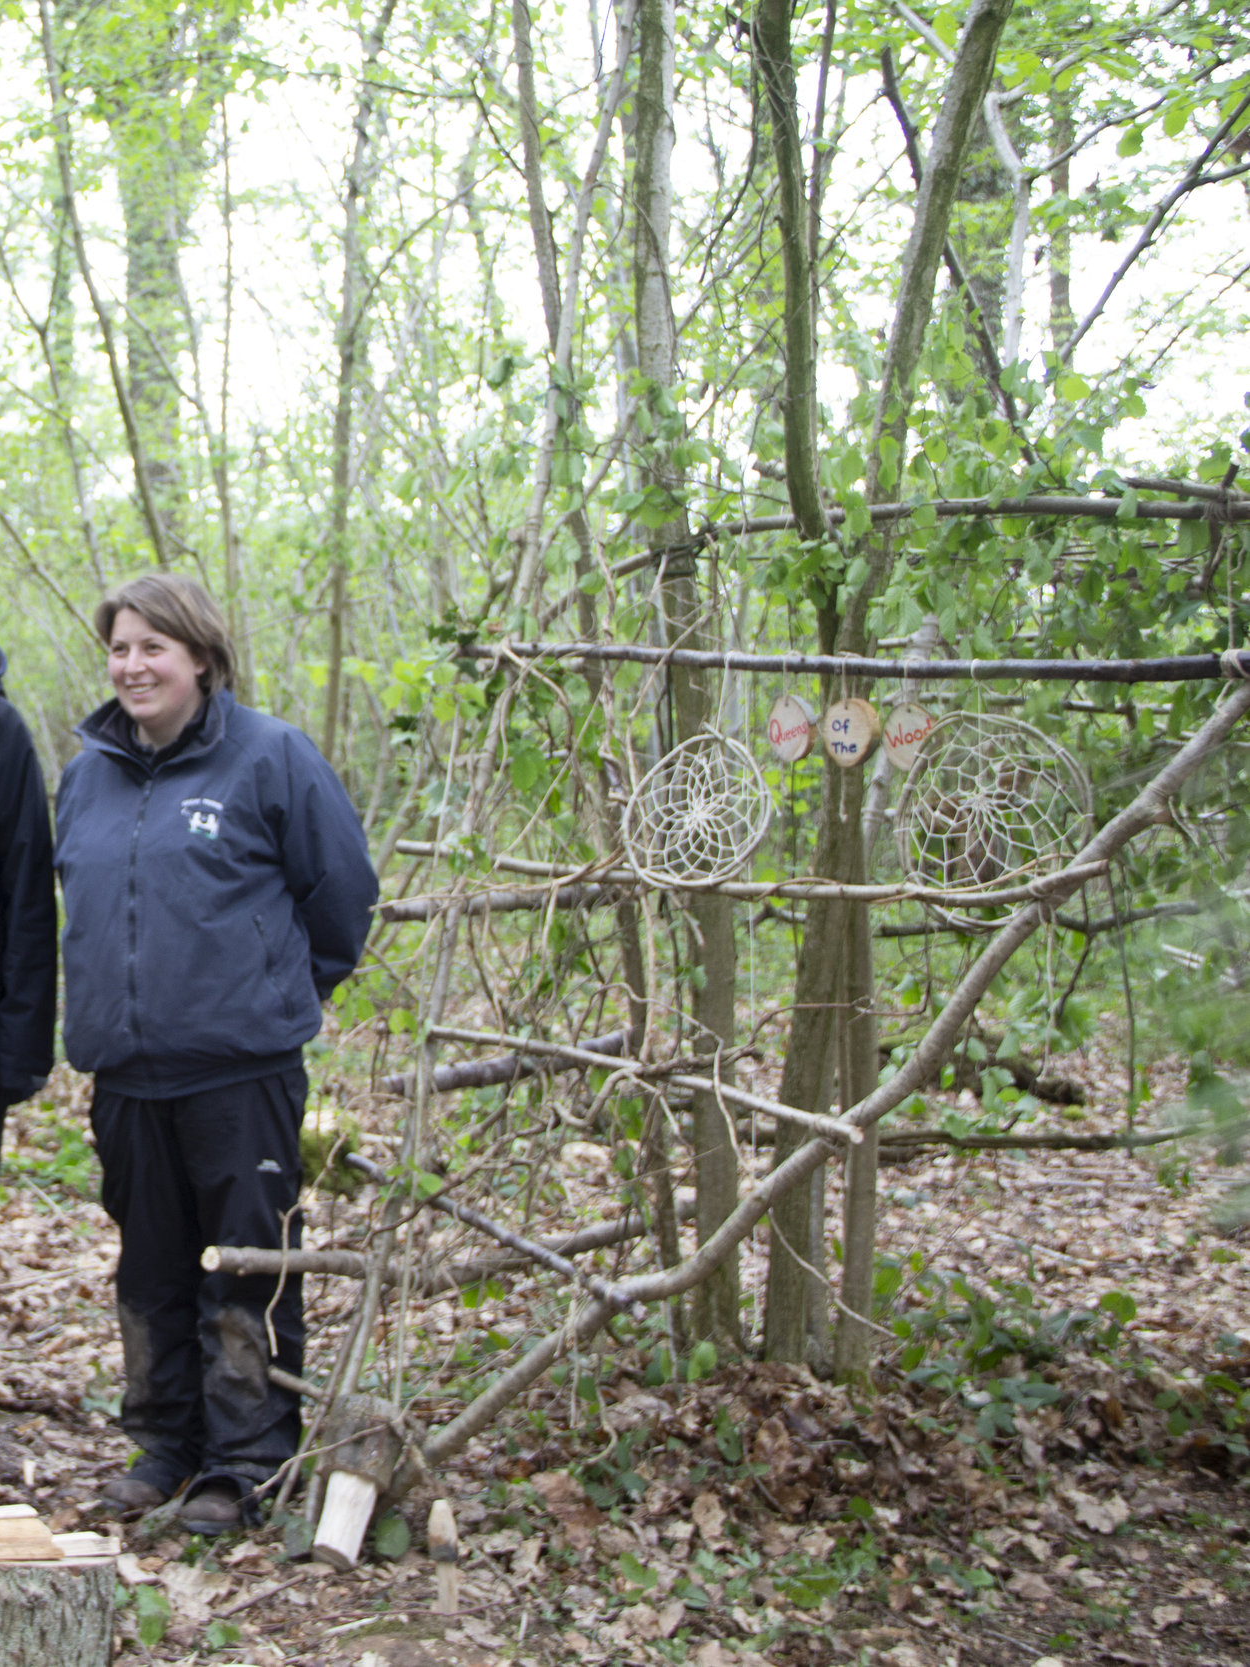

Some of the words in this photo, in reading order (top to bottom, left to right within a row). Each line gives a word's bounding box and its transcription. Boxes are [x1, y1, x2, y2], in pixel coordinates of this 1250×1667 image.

[769, 718, 807, 746] Queens
[831, 718, 850, 735] Of
[831, 742, 857, 753] The
